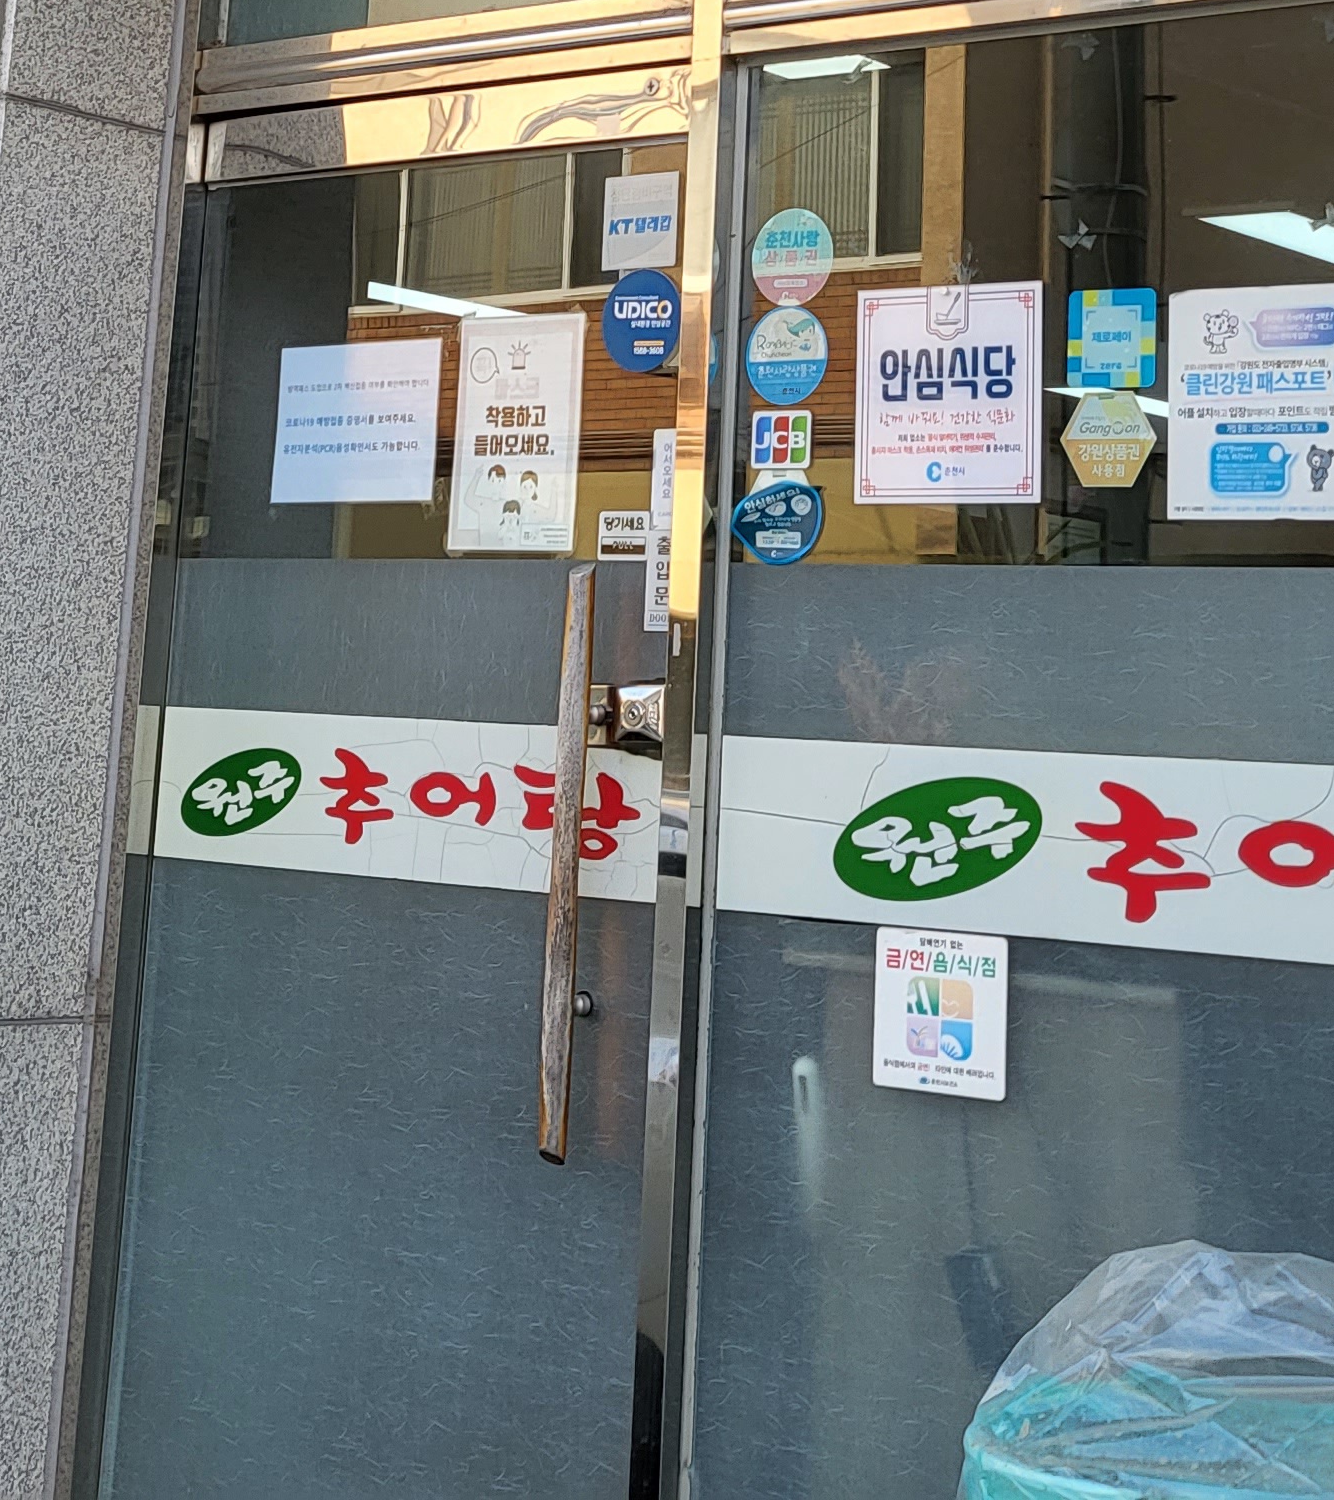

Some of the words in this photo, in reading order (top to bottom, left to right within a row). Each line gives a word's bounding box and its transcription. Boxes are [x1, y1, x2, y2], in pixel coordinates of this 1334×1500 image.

[765, 229, 820, 249] 춘천사랑
[614, 299, 673, 319] UDICO
[1091, 330, 1132, 343] 제로페이
[880, 345, 1017, 402] 안심식당
[285, 417, 315, 428] 코로나19
[346, 414, 375, 426] 증명서를
[376, 412, 417, 425] 보여주세요.
[485, 405, 547, 428] 착용하고
[950, 411, 982, 425] 건강한
[381, 440, 420, 452] 가능합니다.
[474, 433, 555, 457] 들어오세요.
[755, 431, 805, 449] JCB
[1078, 444, 1140, 462] 강원상품권
[661, 442, 673, 499] 어서오세요
[604, 516, 645, 531] 당기세요
[654, 536, 671, 606] 출입문
[649, 612, 667, 623] DOO
[190, 760, 295, 827] 원주
[319, 747, 641, 861] 추어탕
[849, 794, 1034, 885] 원주
